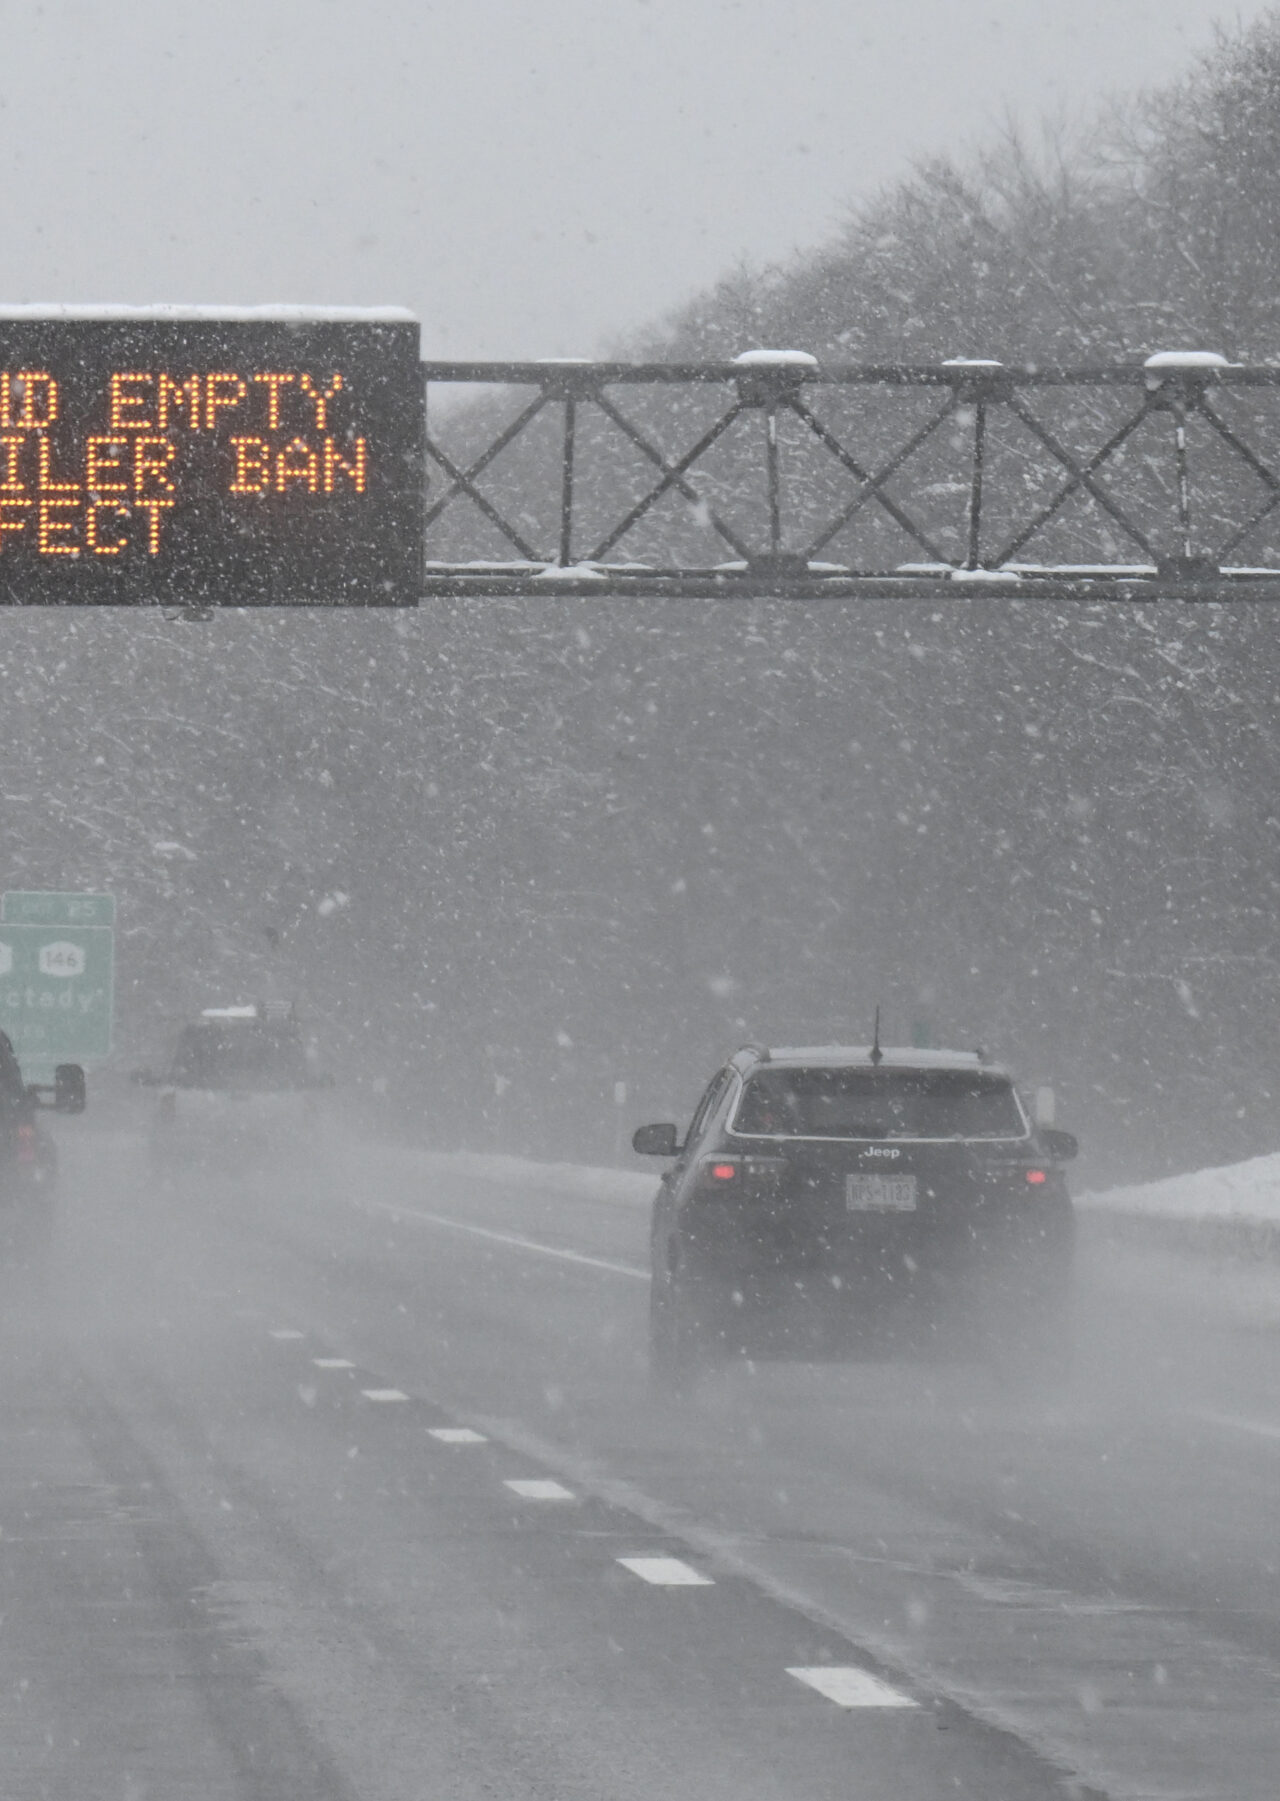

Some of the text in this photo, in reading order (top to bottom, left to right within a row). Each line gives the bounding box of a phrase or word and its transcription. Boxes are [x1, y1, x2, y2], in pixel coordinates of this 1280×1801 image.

[112, 374, 341, 429] EMPTY
[230, 437, 365, 492] BAN
[45, 949, 78, 968] 146
[864, 1146, 901, 1159] Jeep
